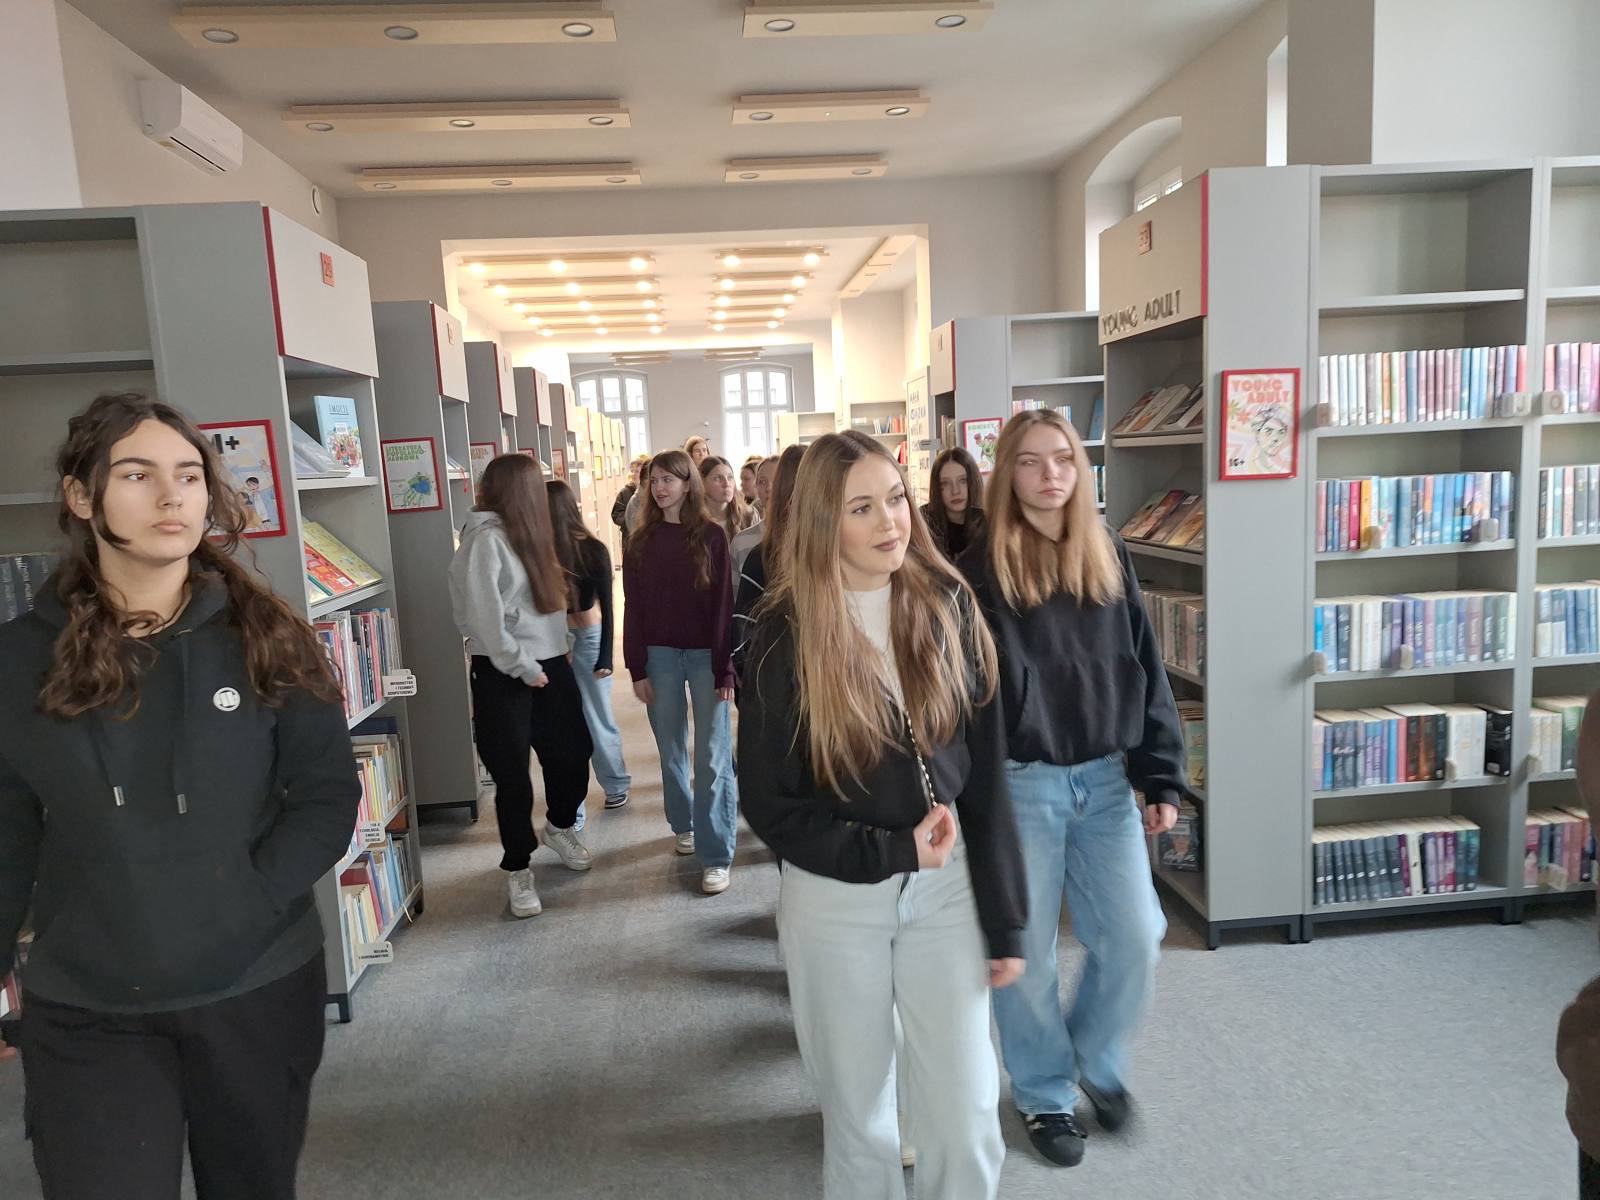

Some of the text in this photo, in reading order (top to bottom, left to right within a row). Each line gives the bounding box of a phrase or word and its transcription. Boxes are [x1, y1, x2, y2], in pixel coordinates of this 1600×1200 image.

[1102, 289, 1180, 336] YOUNG ADULT
[1231, 380, 1282, 391] YOUNG
[1247, 390, 1290, 403] ADULT
